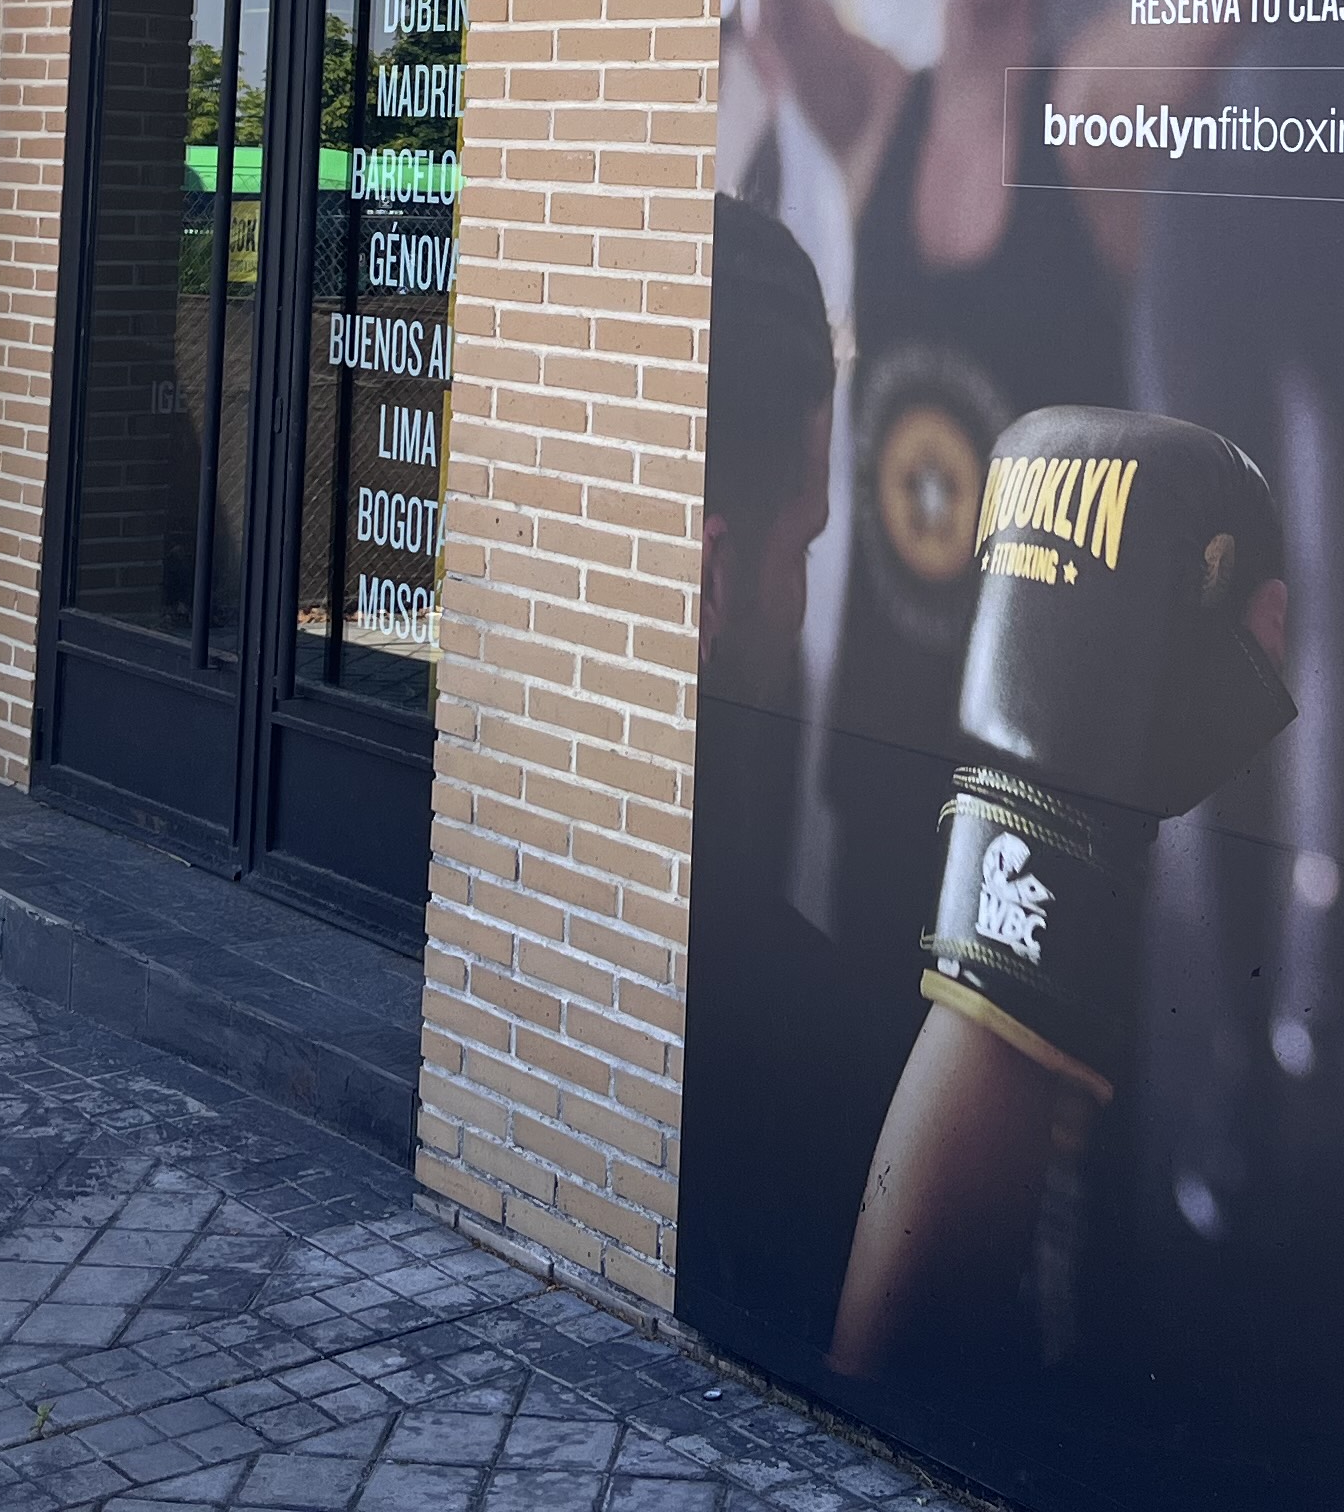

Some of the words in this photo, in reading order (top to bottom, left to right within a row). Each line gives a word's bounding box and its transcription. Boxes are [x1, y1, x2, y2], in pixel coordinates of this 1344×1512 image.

[351, 148, 462, 206] BARCELO
[328, 312, 424, 377] BUENOS
[378, 404, 437, 467] LIMA
